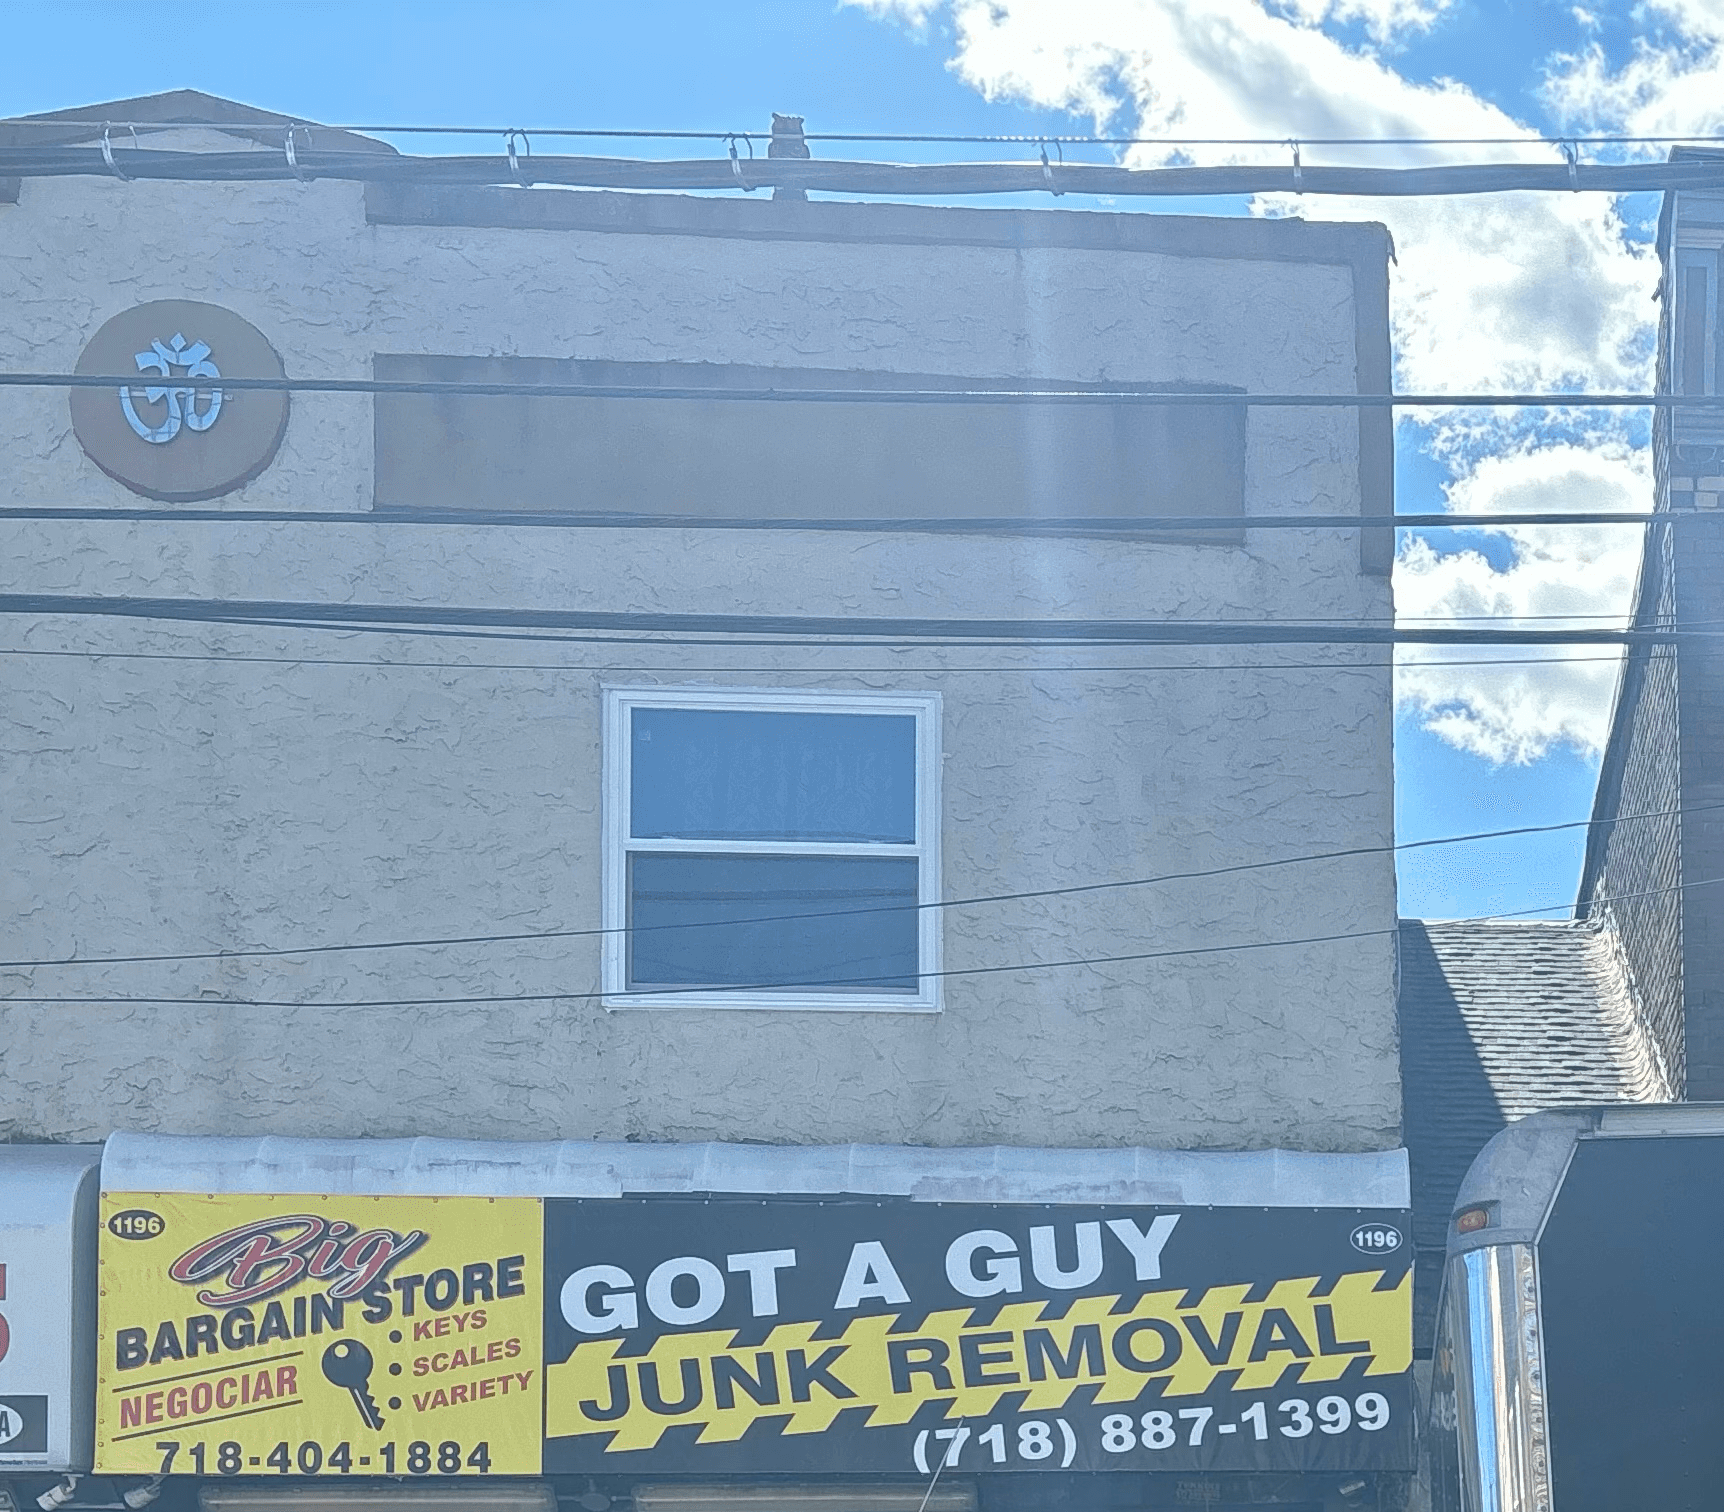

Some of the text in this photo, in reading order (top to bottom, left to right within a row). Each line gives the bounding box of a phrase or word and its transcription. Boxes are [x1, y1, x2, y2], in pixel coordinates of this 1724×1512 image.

[113, 1216, 161, 1235] 1196
[1355, 1230, 1398, 1249] 1196
[168, 1214, 430, 1308] Big
[560, 1214, 1182, 1334] GOT A GUY
[116, 1255, 526, 1371] BARGAIN STORE
[412, 1310, 488, 1342] KEYS
[412, 1338, 521, 1377] SCALES
[578, 1302, 1371, 1422] JUNK REMOVAL
[120, 1365, 298, 1429] NEGOCIAR
[412, 1370, 534, 1412] VARIETY
[155, 1441, 492, 1474] 718-404-1884
[914, 1419, 1077, 1473] (718)
[1100, 1392, 1390, 1453] 887-1399
